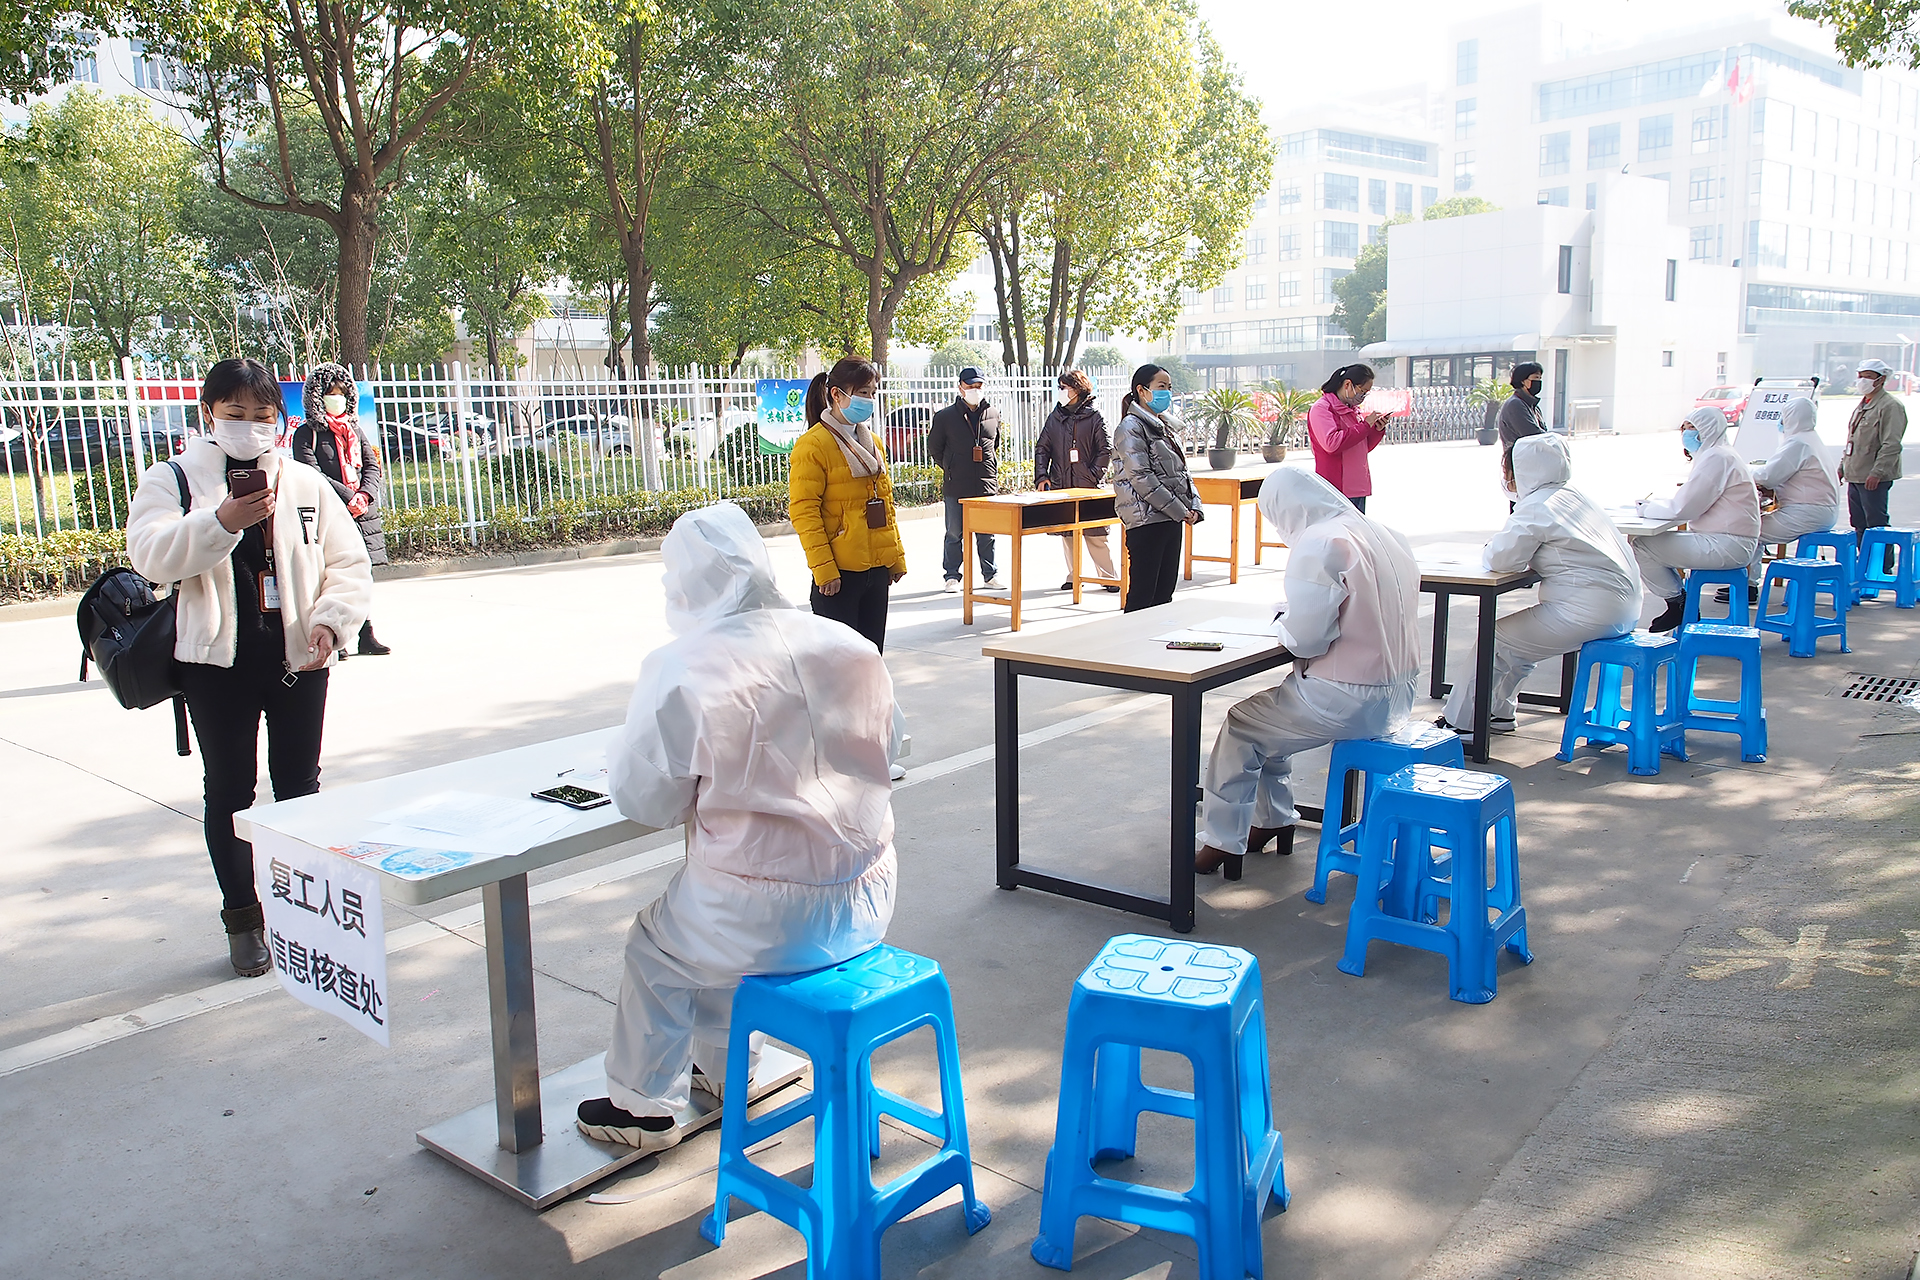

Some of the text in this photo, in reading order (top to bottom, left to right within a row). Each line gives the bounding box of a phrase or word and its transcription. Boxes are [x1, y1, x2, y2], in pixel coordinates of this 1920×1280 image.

[1763, 393, 1789, 403] 复工人员
[269, 856, 366, 939] 复工人员
[270, 927, 384, 1026] 信息核查处
